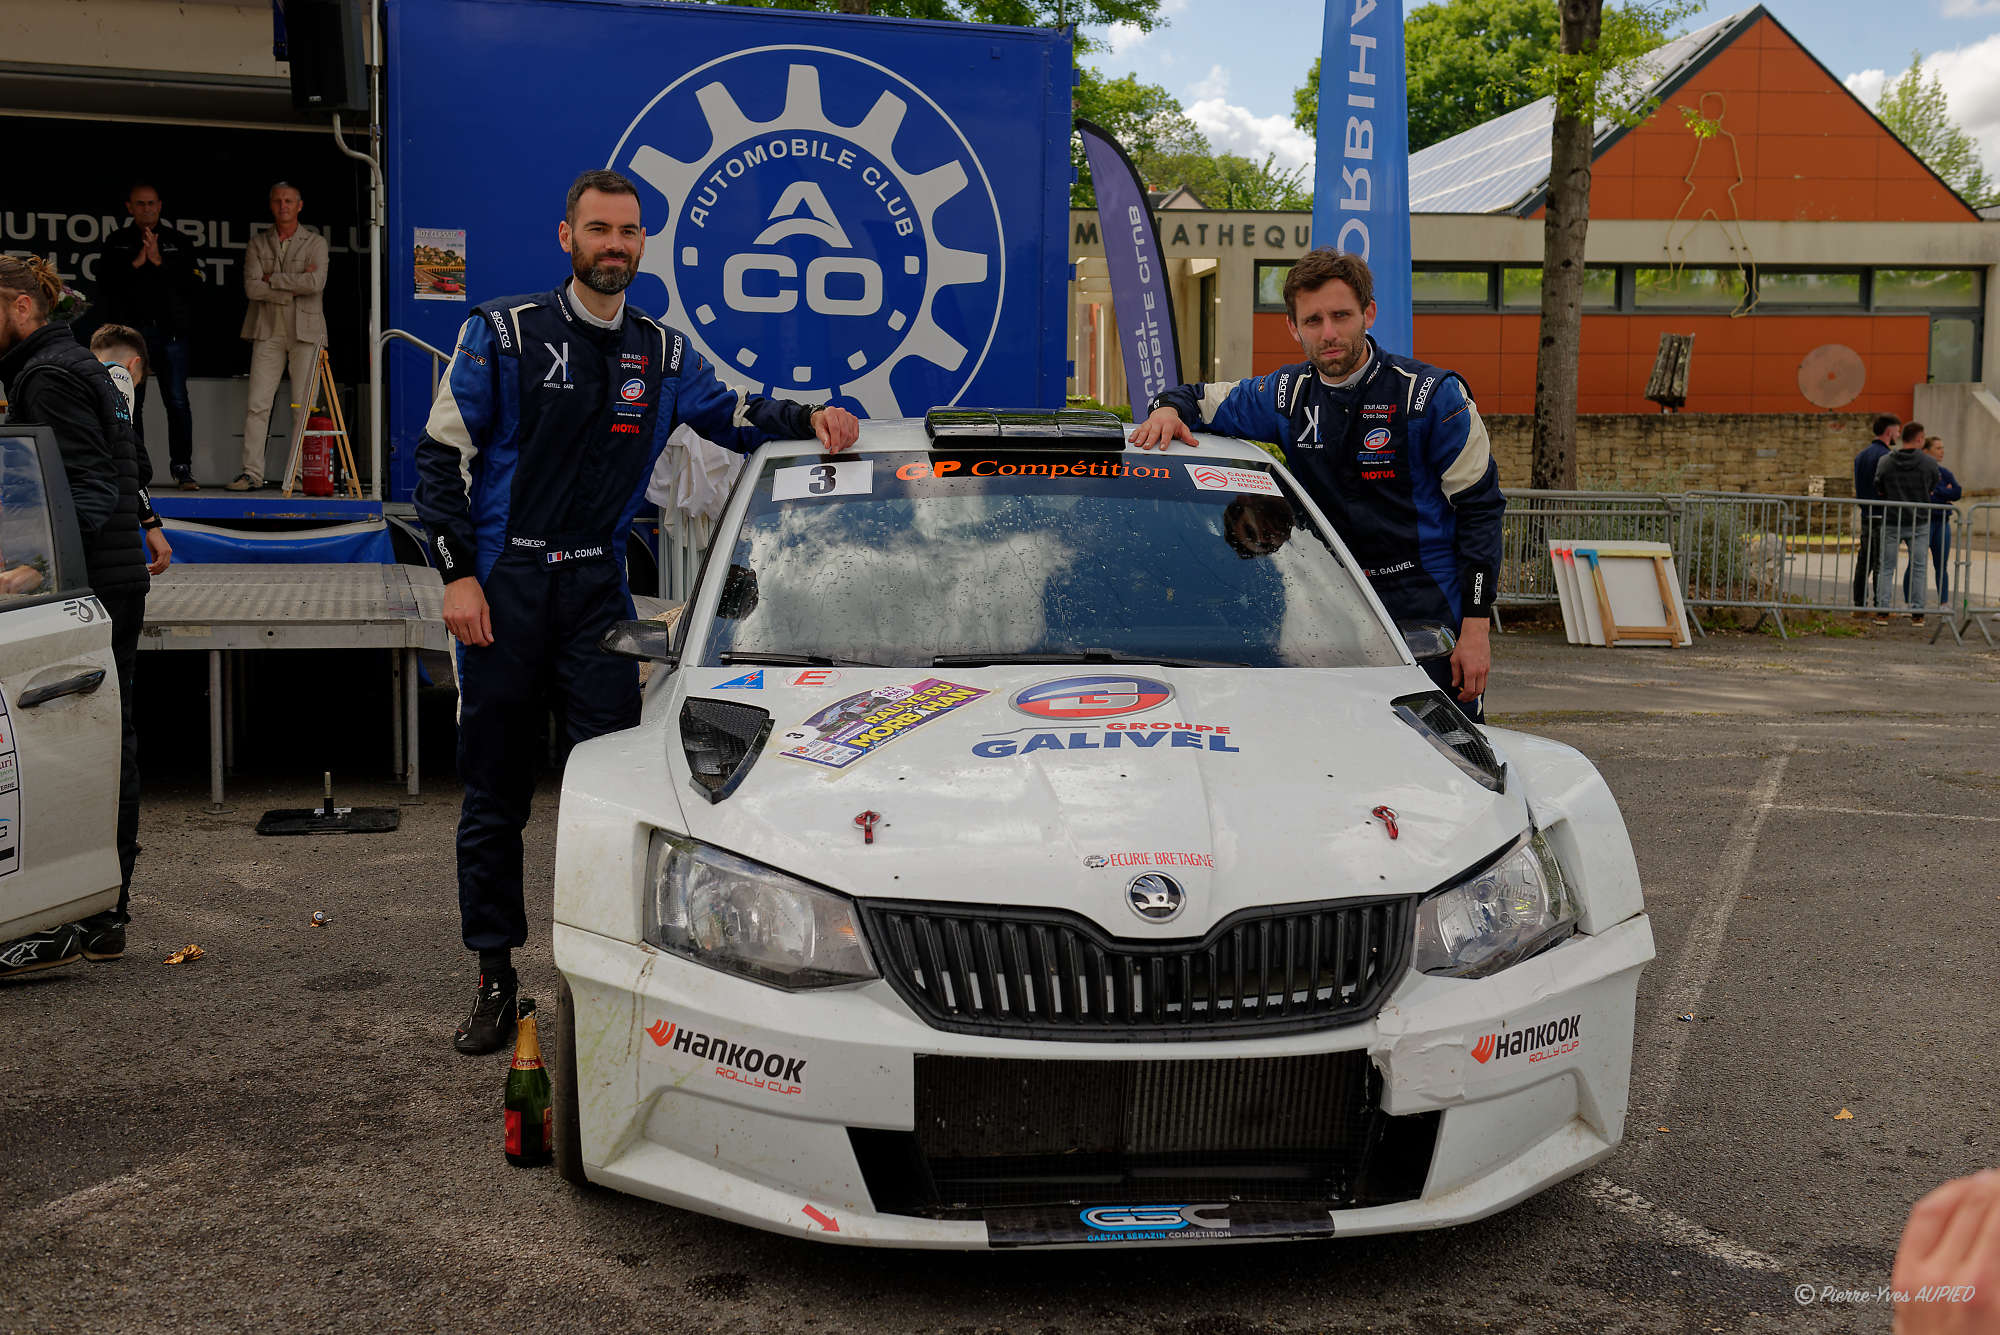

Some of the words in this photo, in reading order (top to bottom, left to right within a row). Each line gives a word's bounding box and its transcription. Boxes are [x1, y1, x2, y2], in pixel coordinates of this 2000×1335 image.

[690, 139, 857, 229] AUTOMOBILE
[861, 166, 915, 237] CLUB
[490, 310, 512, 349] sparco
[670, 335, 683, 371] sparco
[1277, 373, 1290, 409] sparco
[1414, 376, 1436, 412] sparco
[610, 423, 640, 434] MOTUL
[808, 465, 837, 494] 3
[896, 460, 962, 481] GP
[971, 460, 1172, 480] Compétition
[1361, 469, 1396, 480] MOTUL
[437, 535, 454, 569] sparco
[511, 537, 546, 548] sparco
[563, 551, 574, 560] A.
[574, 546, 603, 558] CONAN
[1380, 560, 1415, 575] GALIVEL
[1473, 572, 1484, 605] sparco
[863, 692, 930, 724] RALLYE
[923, 683, 953, 697] DU
[1106, 722, 1231, 735] GROUPE
[971, 731, 1240, 758] GALIVEL
[1110, 852, 1151, 867] ECURIE
[1154, 851, 1215, 868] BRETAGNE
[1560, 1040, 1580, 1055] CUP
[767, 1080, 802, 1096] CUP
